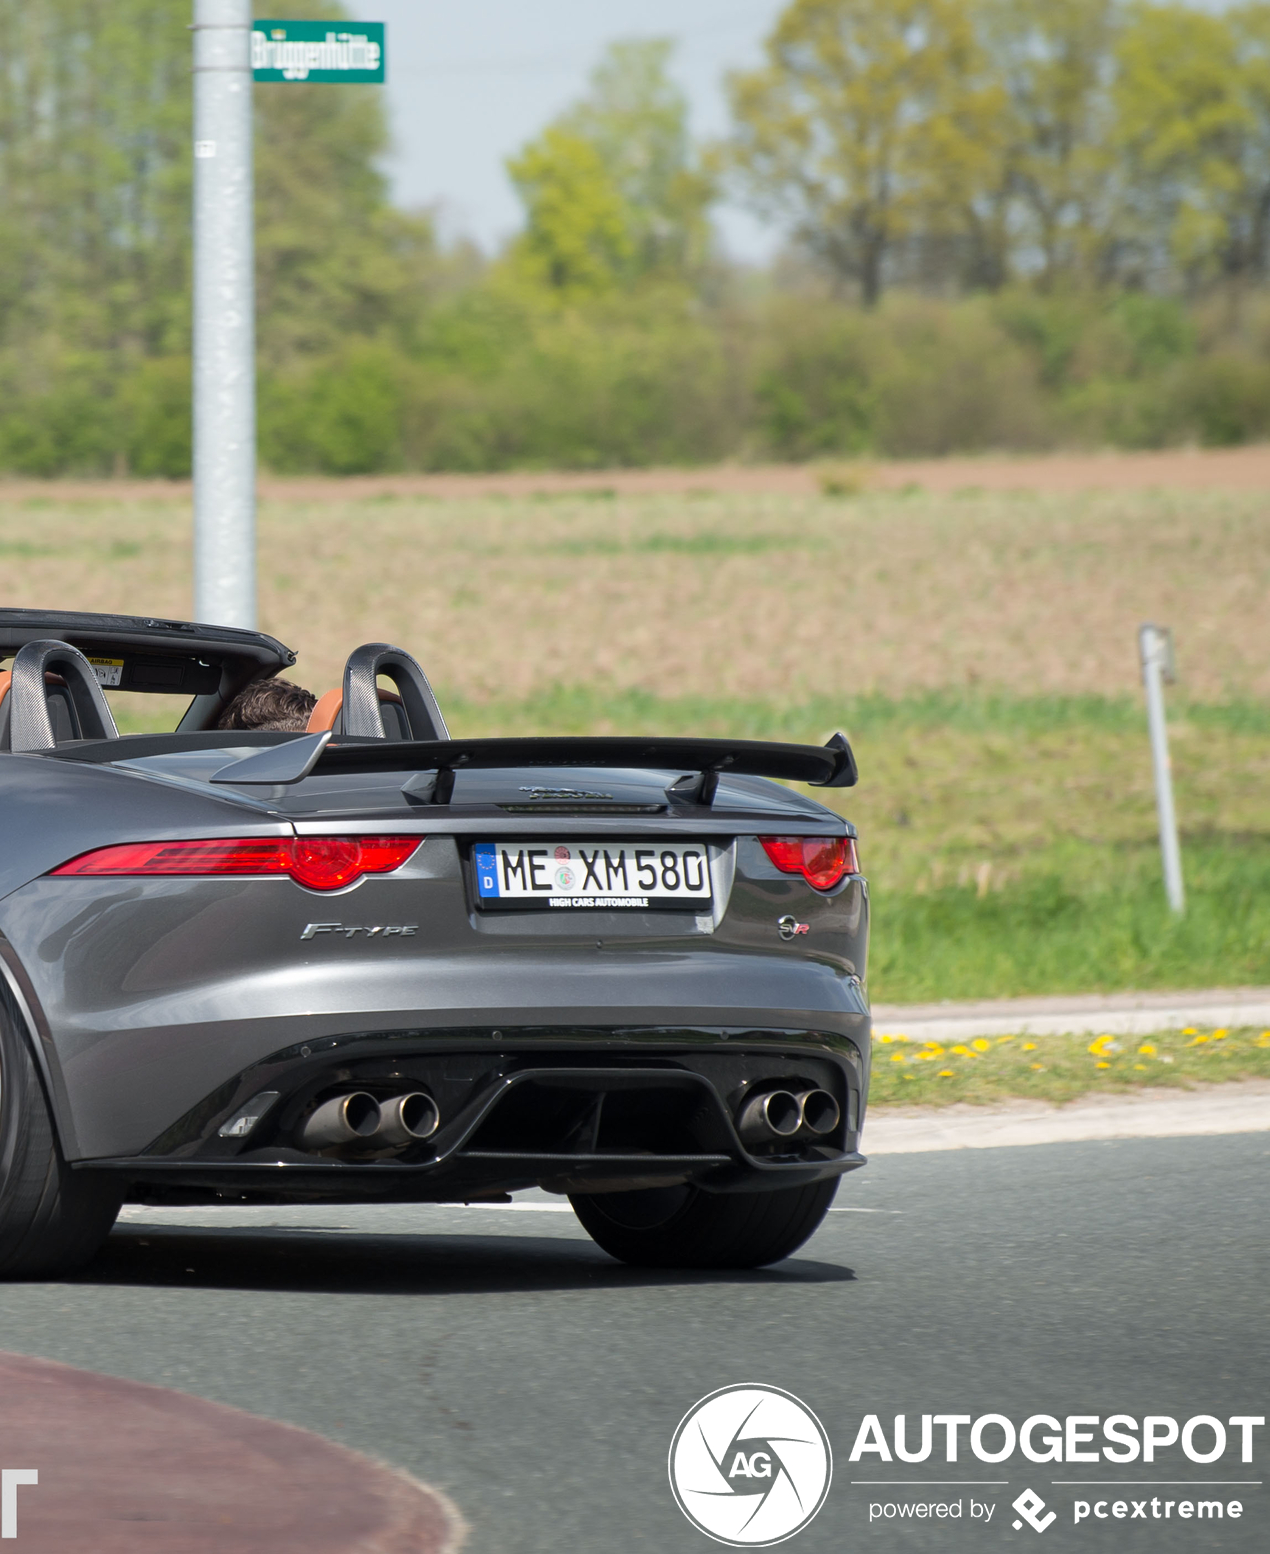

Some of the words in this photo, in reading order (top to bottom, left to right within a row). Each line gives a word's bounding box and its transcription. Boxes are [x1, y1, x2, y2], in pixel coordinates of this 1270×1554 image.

[251, 29, 380, 80] Brüggenhütte
[483, 876, 494, 889] D
[501, 849, 553, 891] ME
[578, 849, 629, 891] XM
[634, 849, 704, 891] 580
[549, 898, 571, 907] HIGH
[572, 898, 594, 907] CARS
[595, 898, 649, 907] AUTOMOBILE
